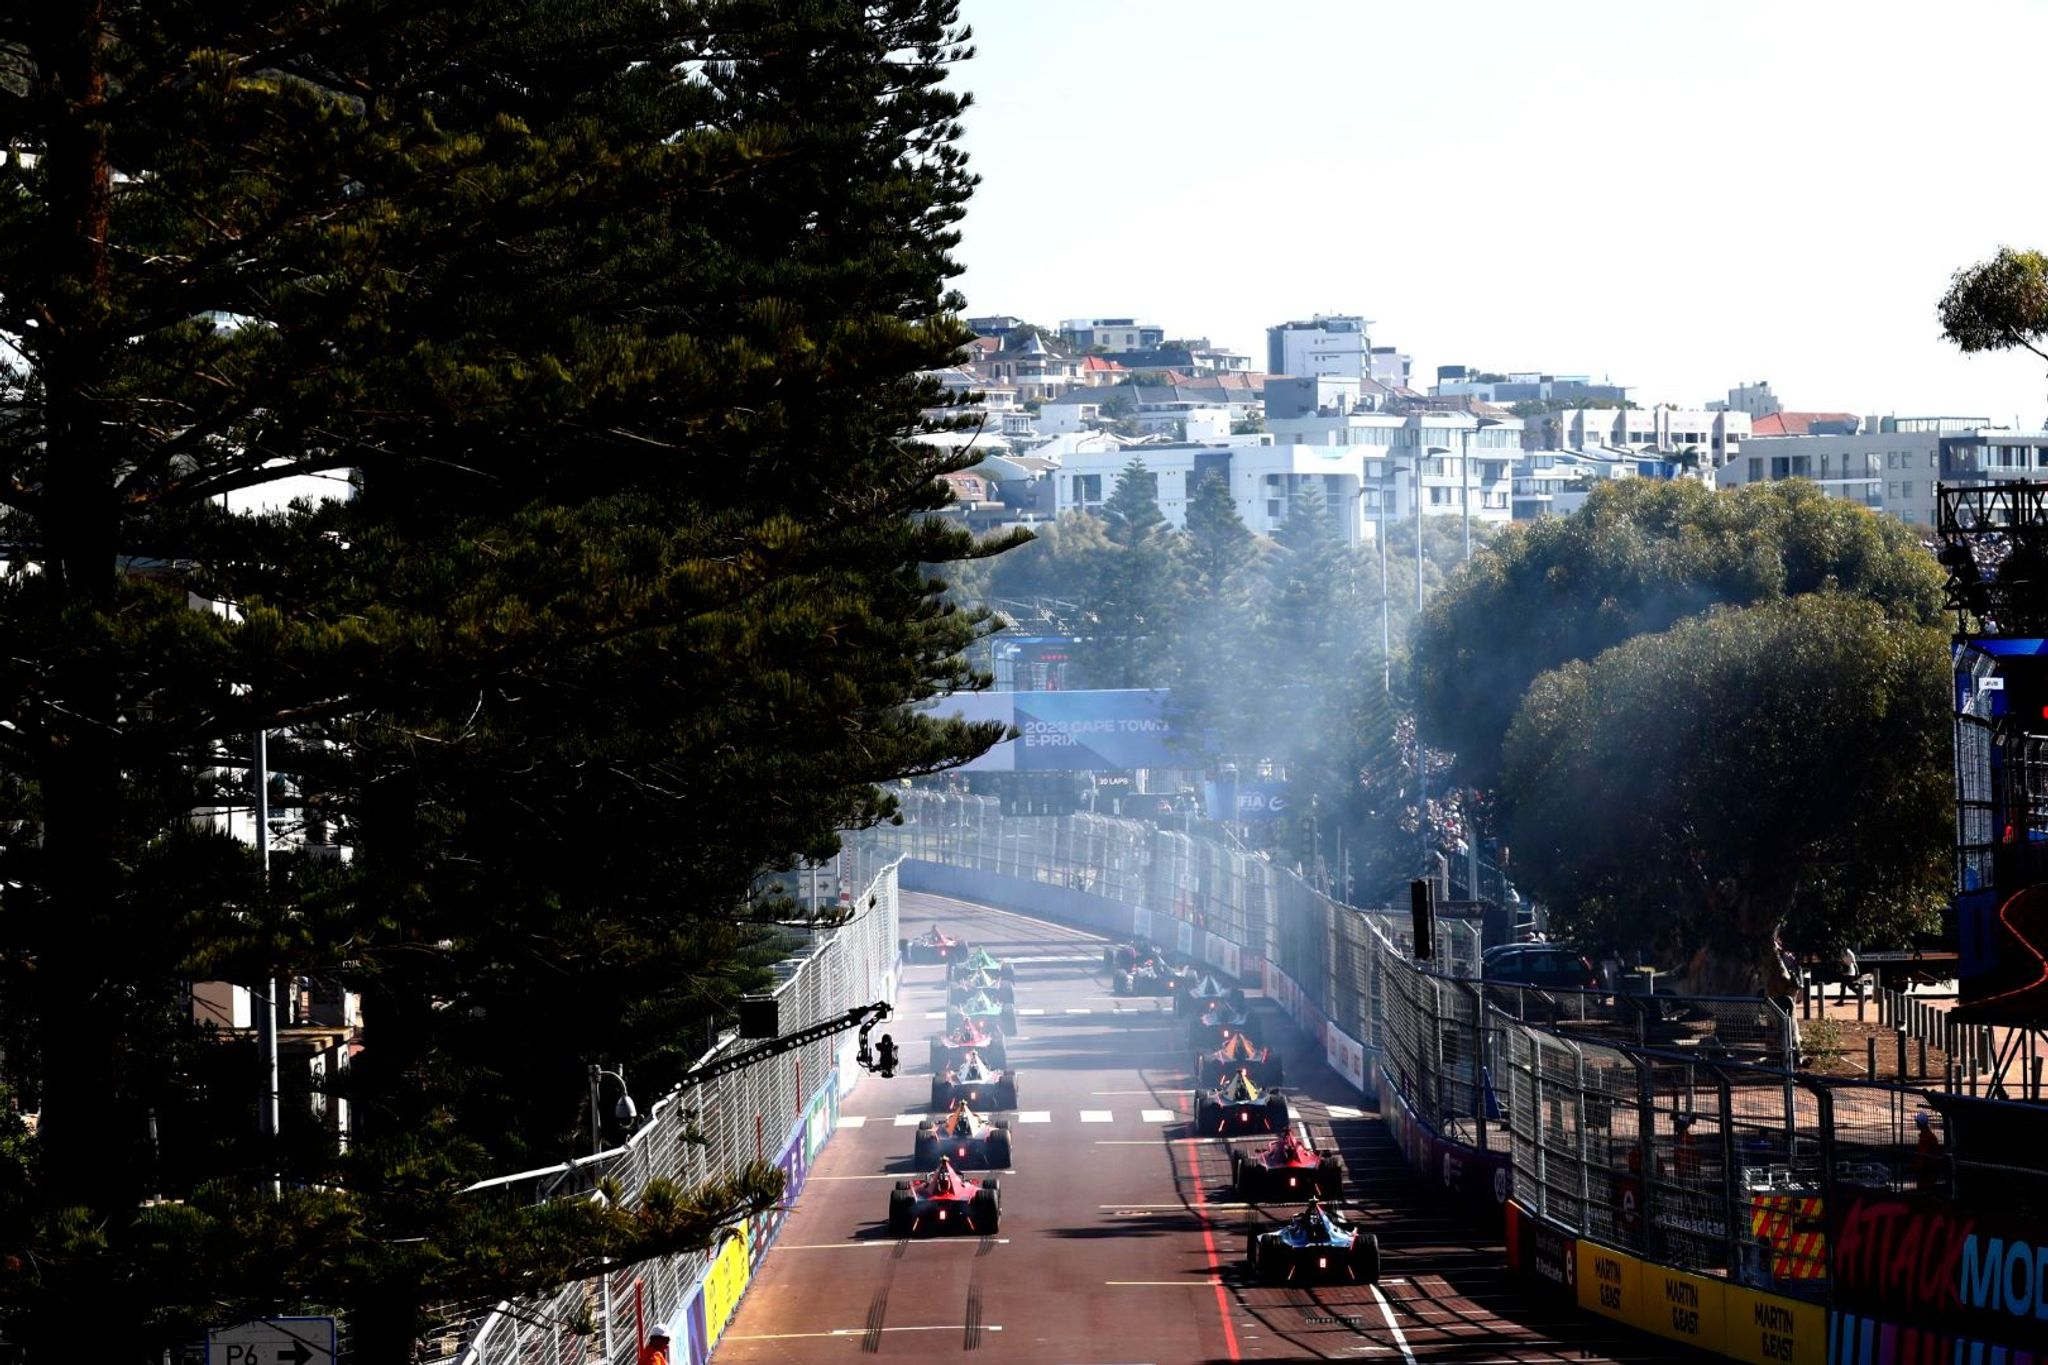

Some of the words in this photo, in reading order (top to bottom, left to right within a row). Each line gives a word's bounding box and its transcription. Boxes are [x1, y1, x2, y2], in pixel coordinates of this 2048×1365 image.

[1071, 720, 1115, 733] CAPE
[1025, 733, 1079, 747] E-PRIX
[1239, 795, 1263, 807] FIA
[1836, 1194, 1978, 1313] ATTACK
[1595, 1255, 1621, 1284] MARTIN
[1666, 1278, 1698, 1308] MARTIN
[1754, 1303, 1794, 1334] MARTIN
[227, 1344, 258, 1365] P6
